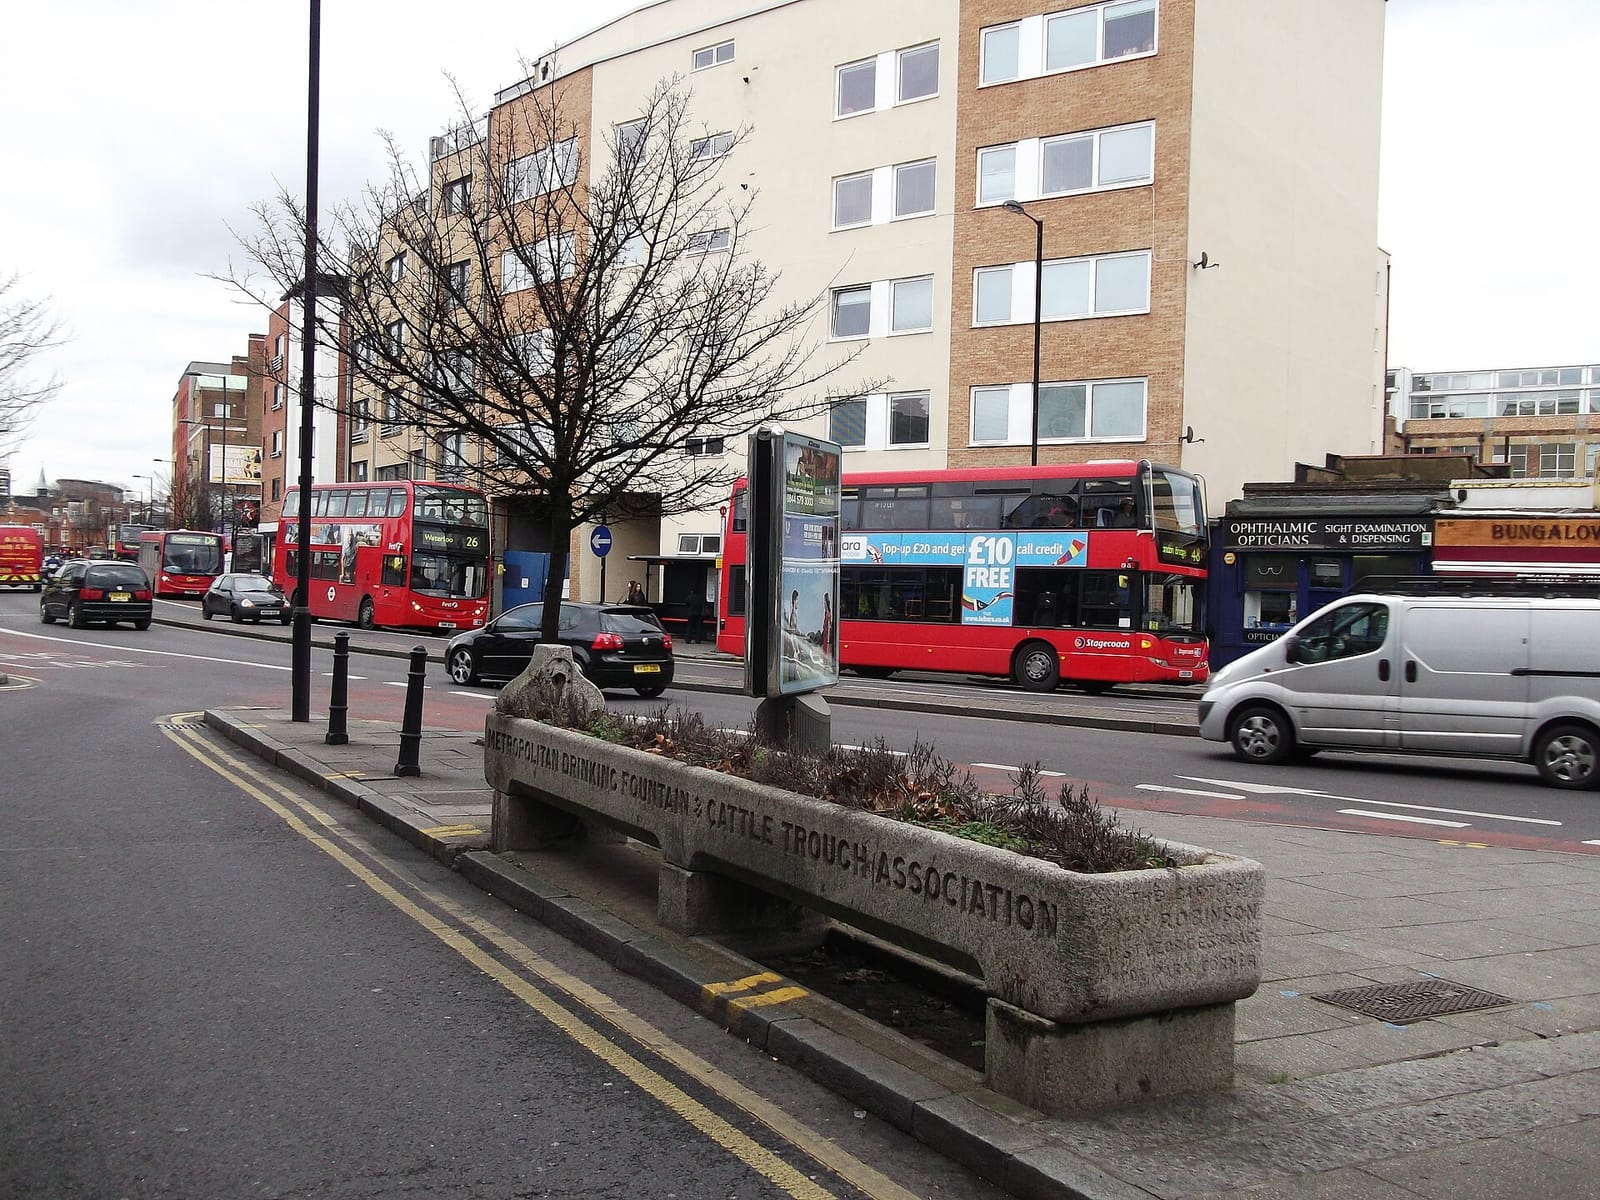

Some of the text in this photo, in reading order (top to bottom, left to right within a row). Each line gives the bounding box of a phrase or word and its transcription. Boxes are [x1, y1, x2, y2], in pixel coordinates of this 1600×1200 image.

[1230, 522, 1318, 534] OPHTHALMIC
[1325, 524, 1352, 533] SIGHT
[1355, 524, 1427, 533] EXAMINATION
[424, 533, 479, 547] Waterloo 26
[1238, 535, 1309, 546] OPTICIANS
[1339, 534, 1411, 543] & DISPENSING
[882, 543, 965, 556] Top-up £20 and get
[968, 536, 1013, 565] £10
[1016, 545, 1063, 555] call credit
[967, 567, 1010, 588] FREE
[1086, 638, 1130, 649] Stagecoach
[488, 729, 559, 773] METROPOLITAN
[562, 752, 618, 792] DRINKING
[621, 772, 690, 817] FOUNTAIN
[706, 799, 774, 845] CATTLE
[781, 821, 869, 878] TROUGH
[874, 852, 1058, 938] ASSOCIATION
